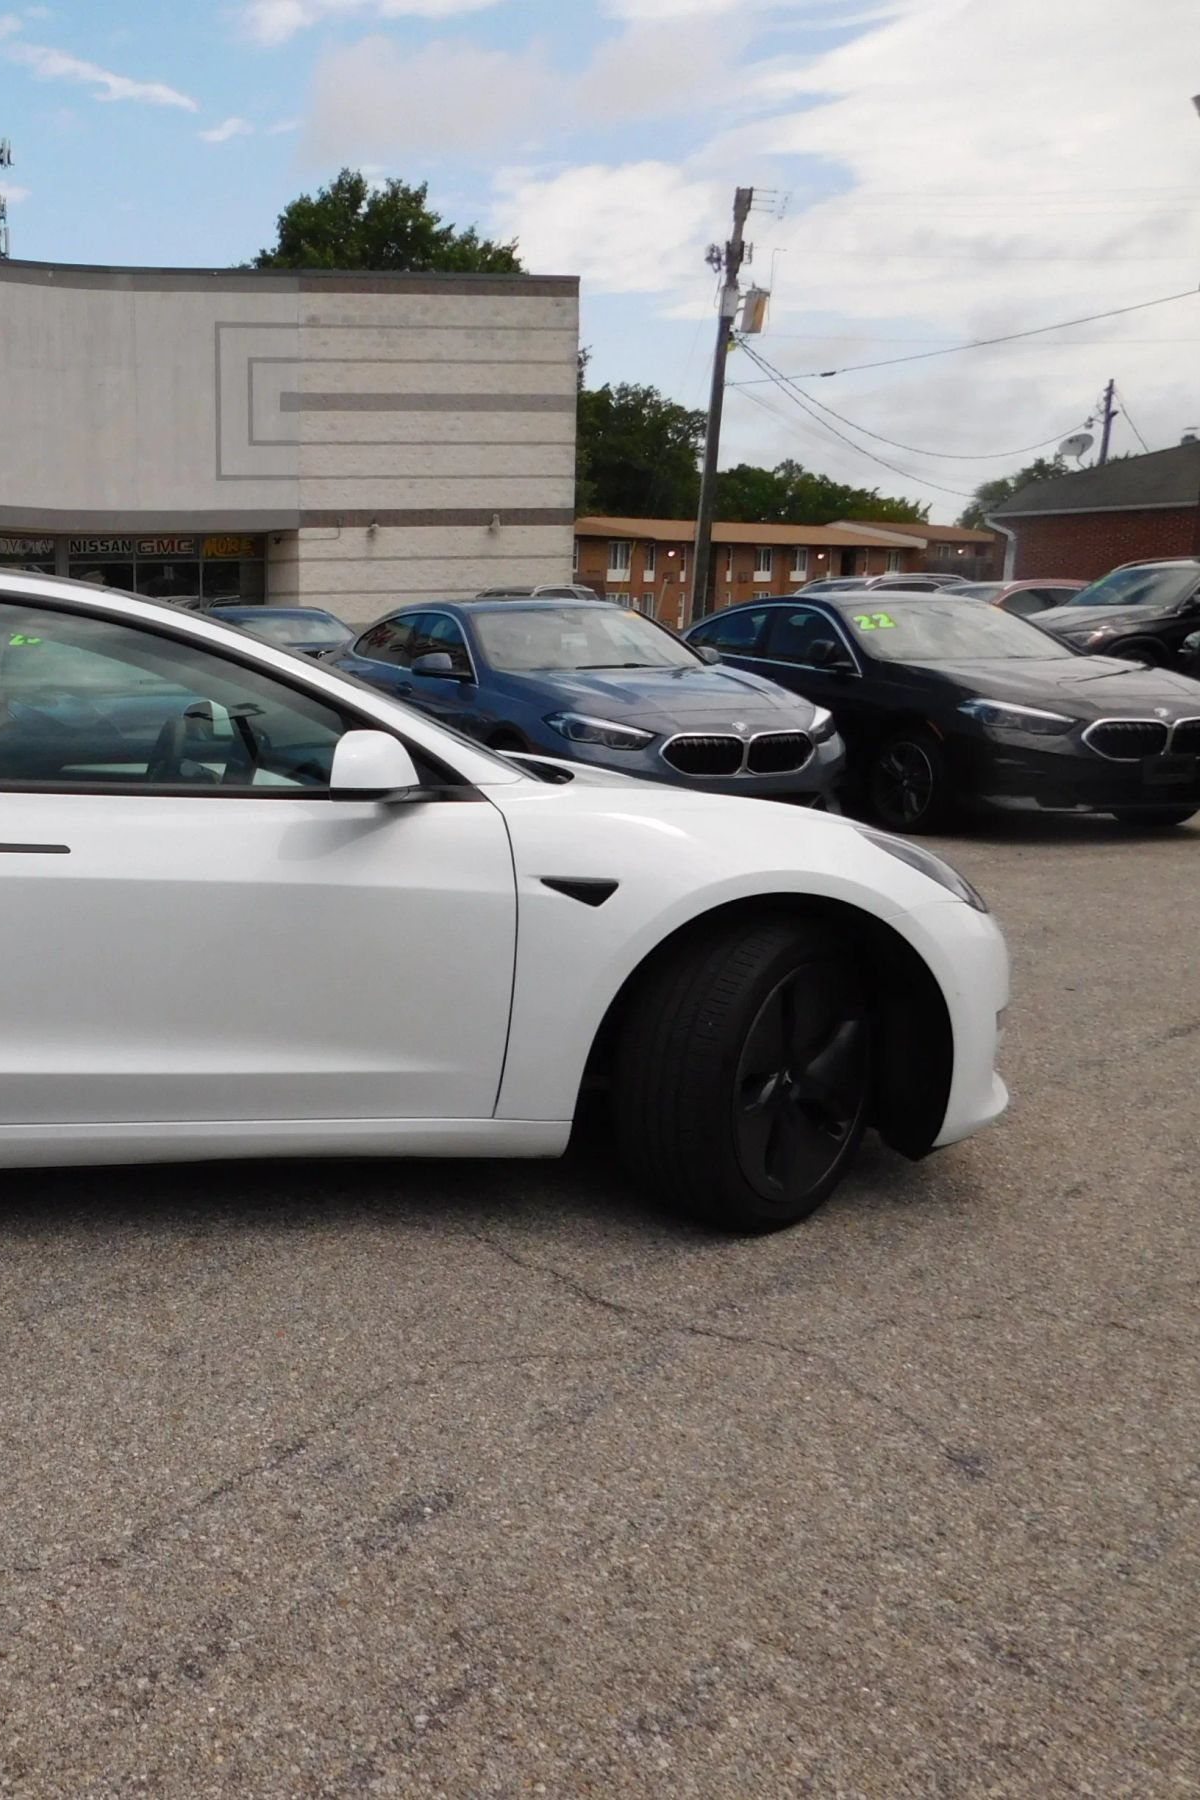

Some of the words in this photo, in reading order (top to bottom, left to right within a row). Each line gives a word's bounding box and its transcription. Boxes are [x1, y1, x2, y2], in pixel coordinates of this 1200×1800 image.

[69, 538, 133, 555] NISSAN
[136, 538, 195, 556] GMC
[853, 612, 896, 631] 22
